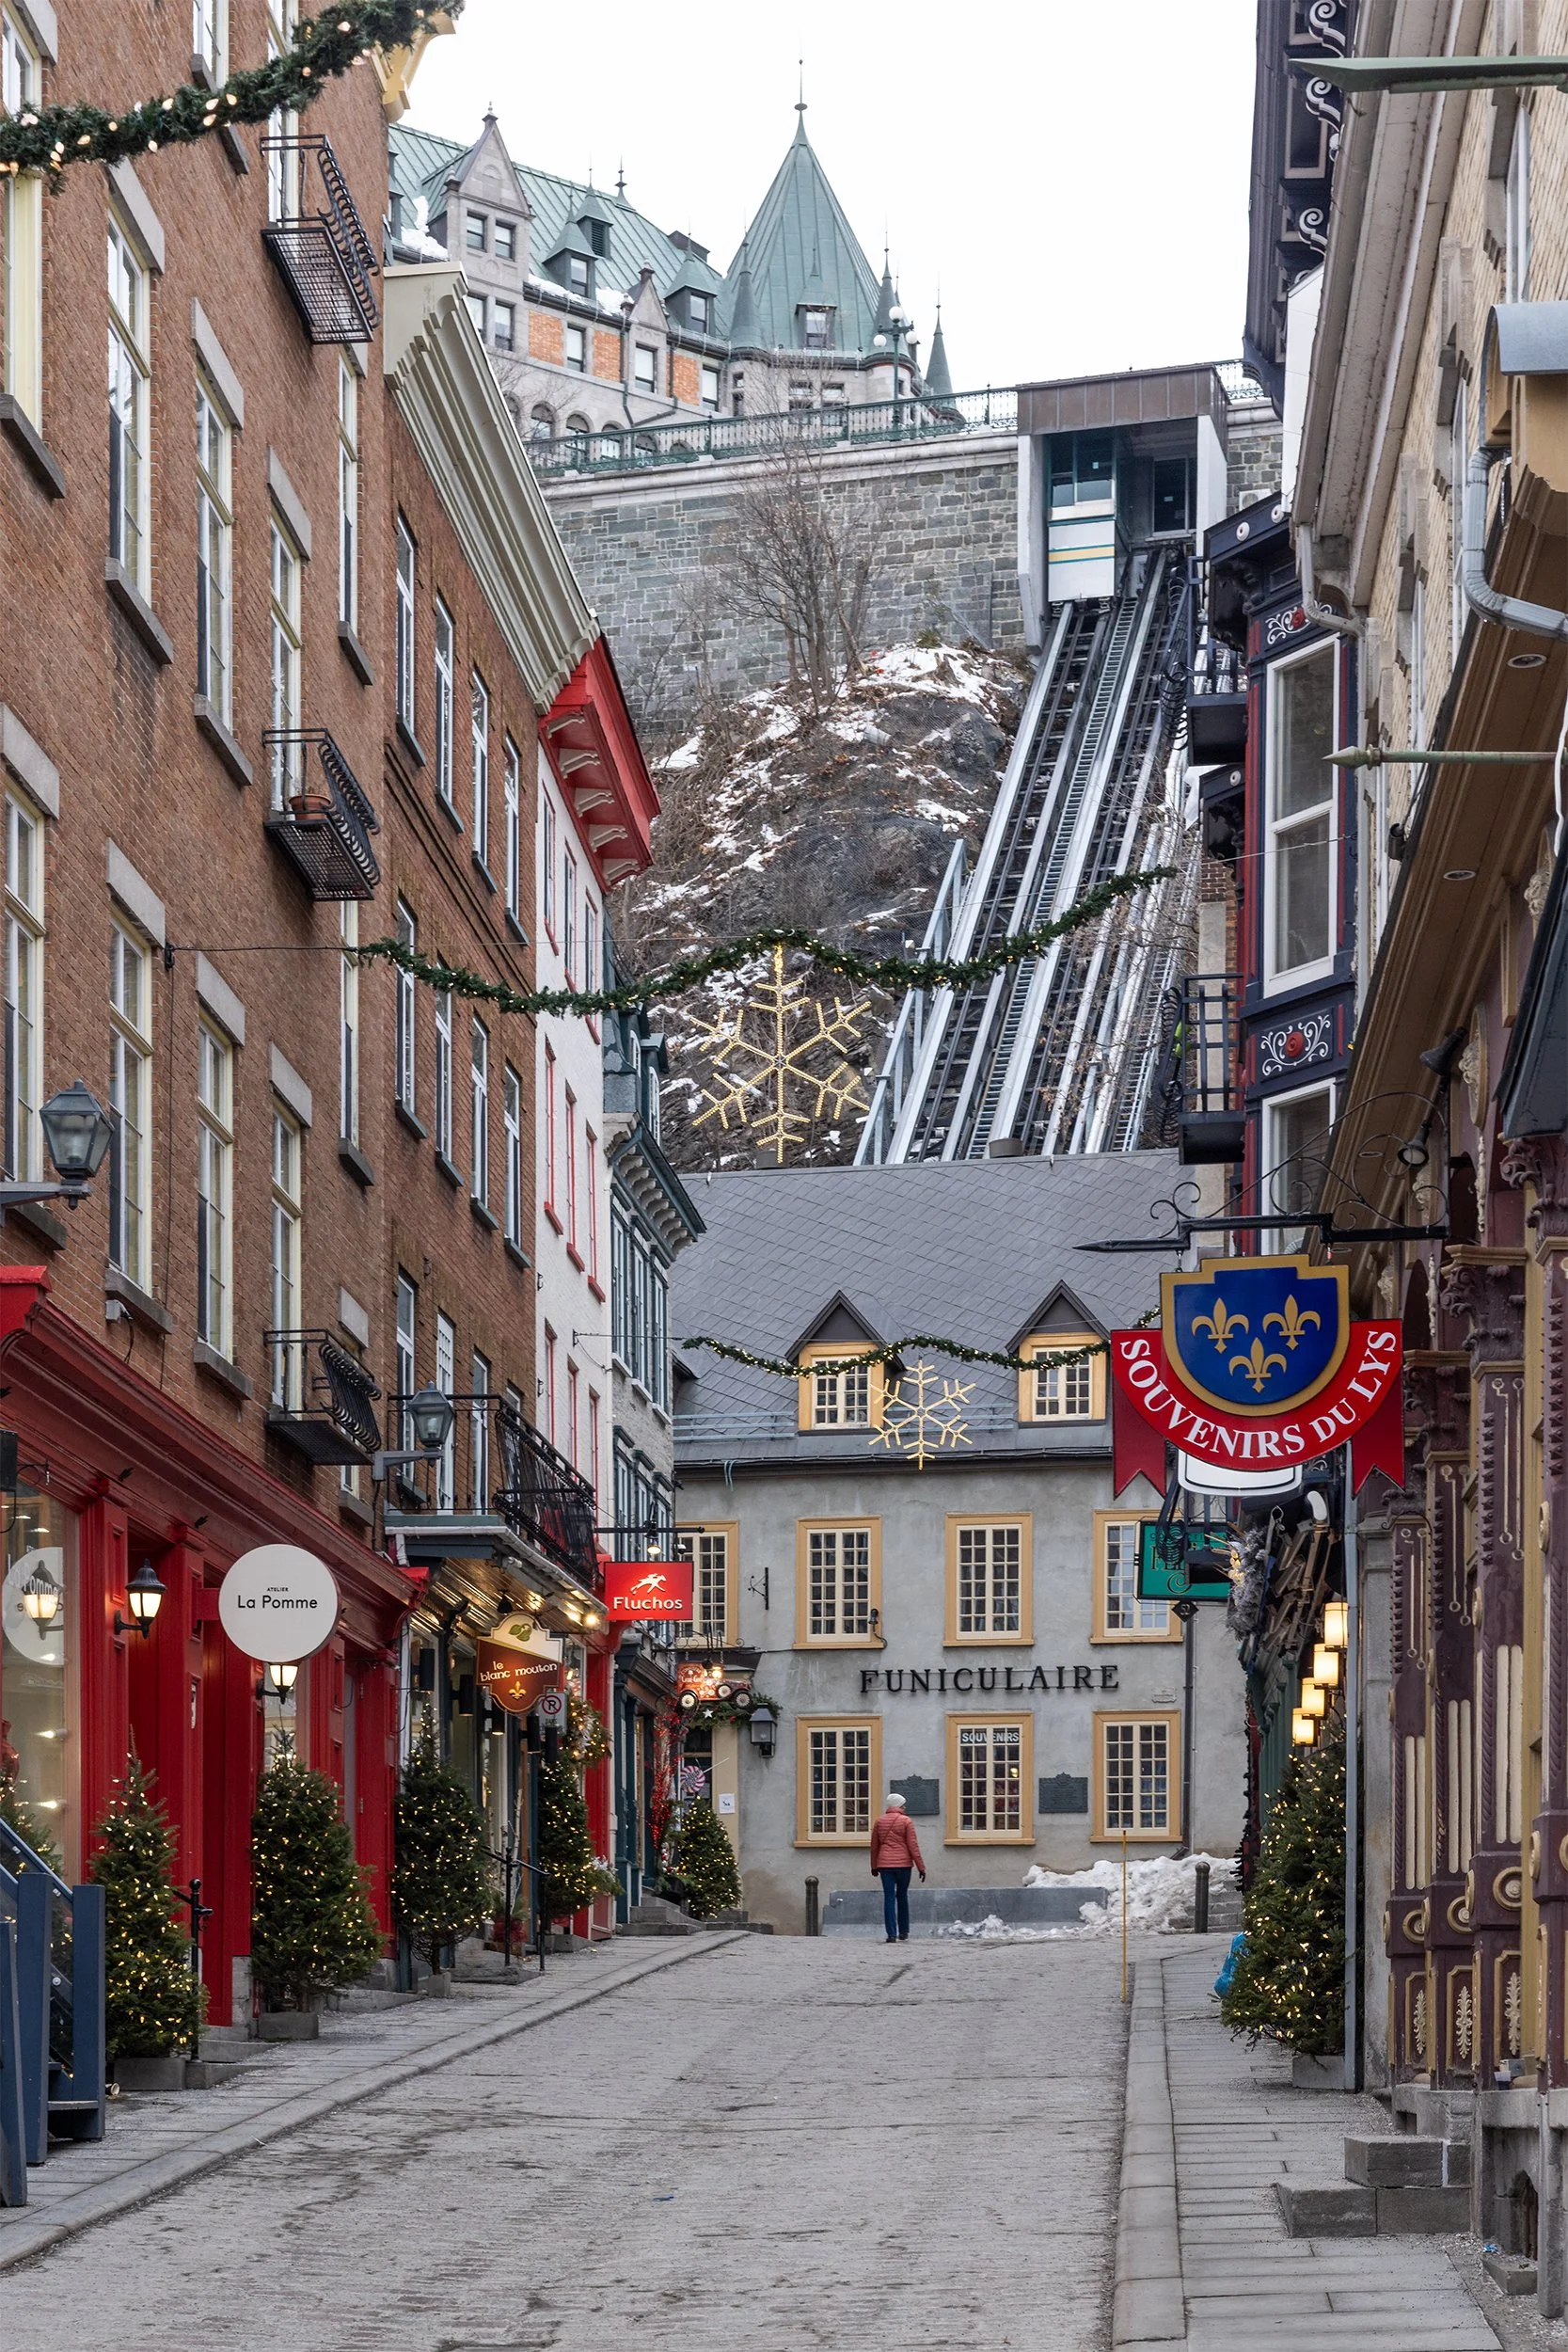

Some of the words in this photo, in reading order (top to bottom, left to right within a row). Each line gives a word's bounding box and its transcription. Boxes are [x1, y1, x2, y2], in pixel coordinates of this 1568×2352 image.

[1120, 1339, 1306, 1458] SOUVENIRS
[1309, 1398, 1356, 1443] DU
[1347, 1330, 1397, 1403] LYS
[237, 1595, 256, 1609] La
[262, 1595, 318, 1609] Pomme
[613, 1597, 683, 1610] Fluchos
[480, 1670, 511, 1682] blanc
[515, 1662, 557, 1677] mouton
[493, 1661, 504, 1671] le
[860, 1664, 1119, 1692] FUNICULAIRE
